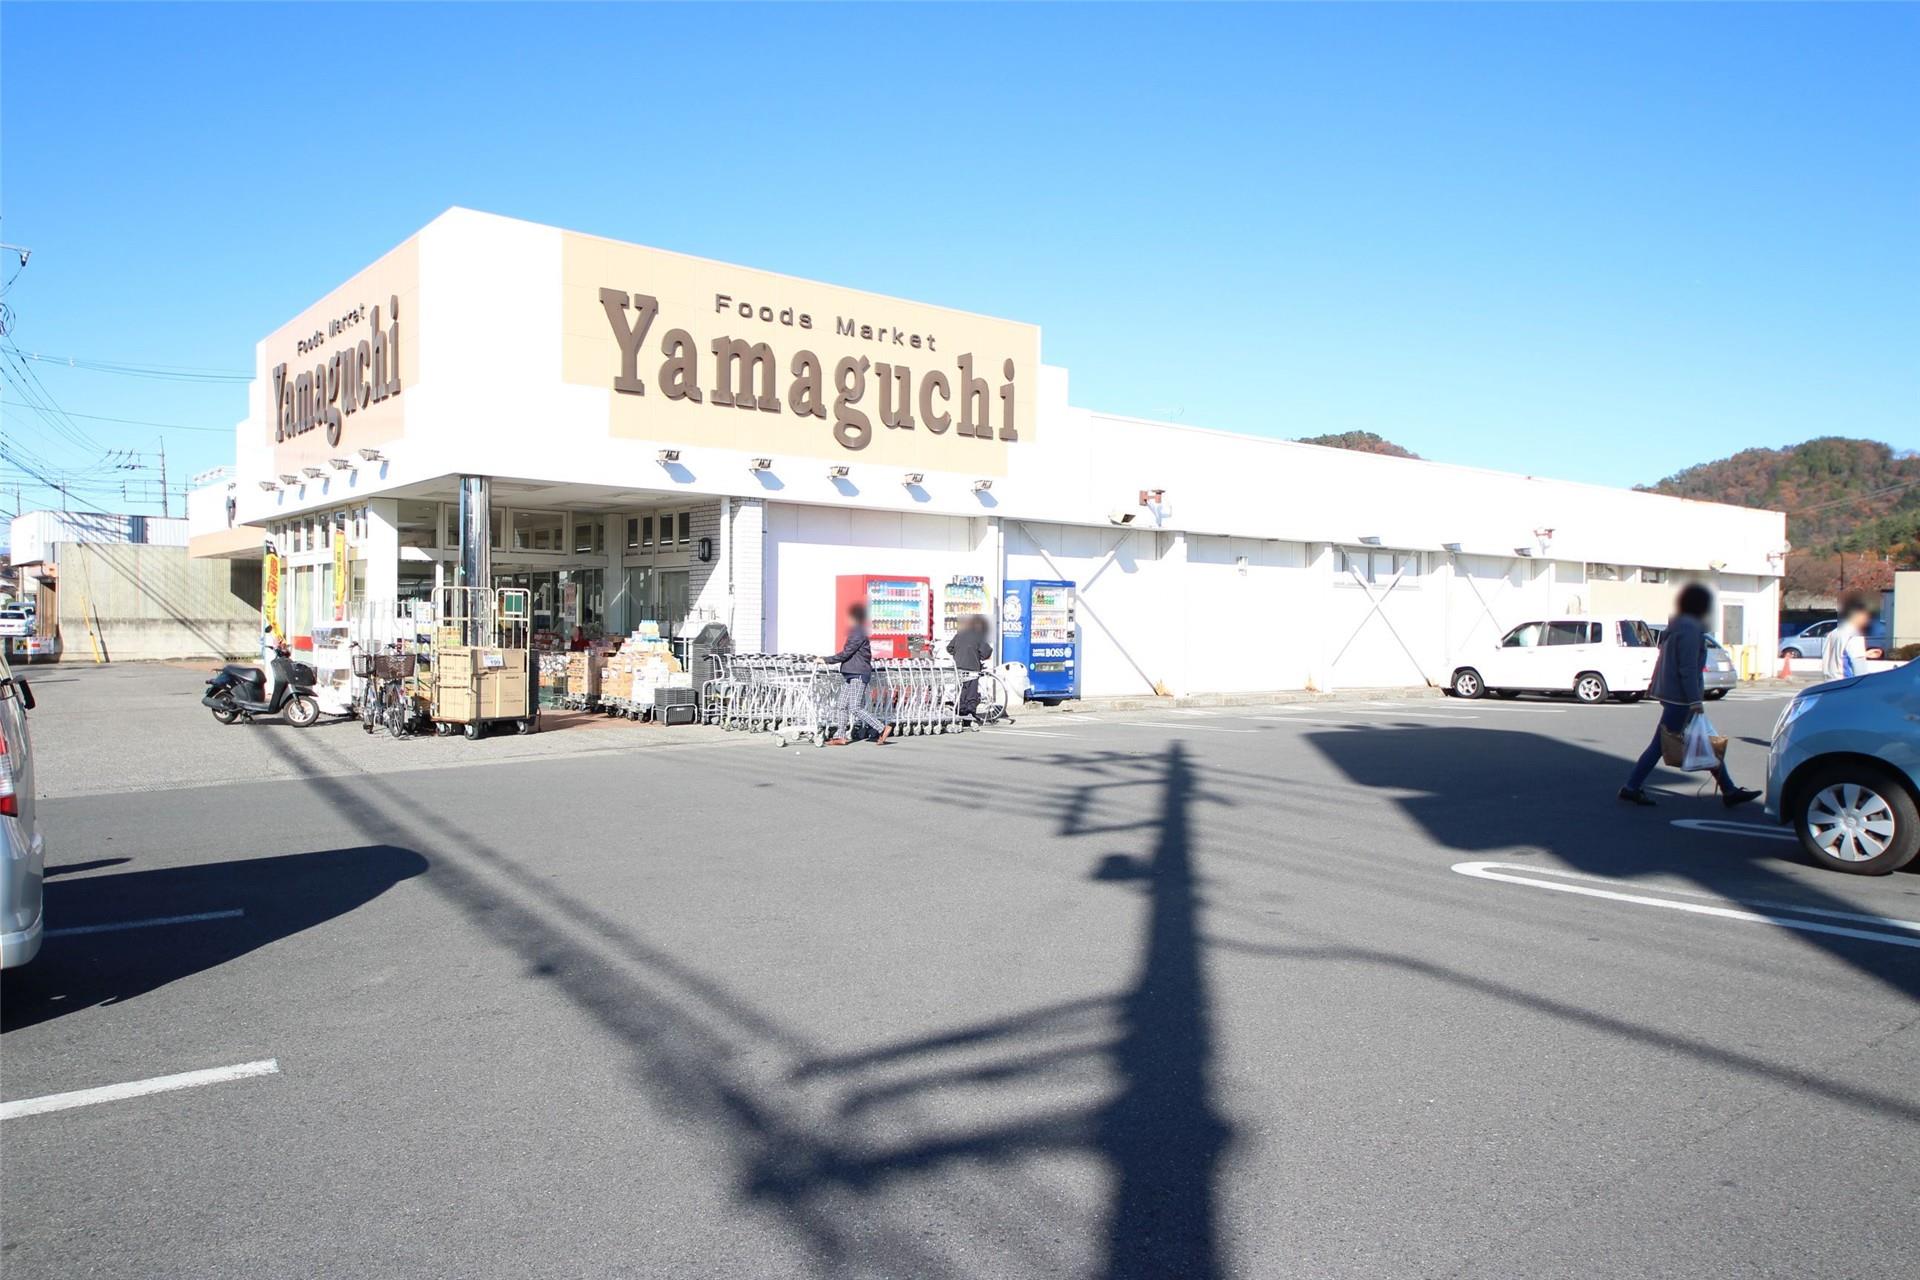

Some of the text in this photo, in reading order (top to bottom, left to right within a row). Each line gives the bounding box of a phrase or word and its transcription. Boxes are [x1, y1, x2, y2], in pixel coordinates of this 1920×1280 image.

[297, 303, 366, 357] Foods Market
[716, 294, 936, 352] Foods Market
[272, 294, 401, 448] Yamaguchi
[599, 287, 1018, 451] Yamaguchi
[1003, 621, 1022, 631] BOSS
[1045, 648, 1064, 657] BOSS
